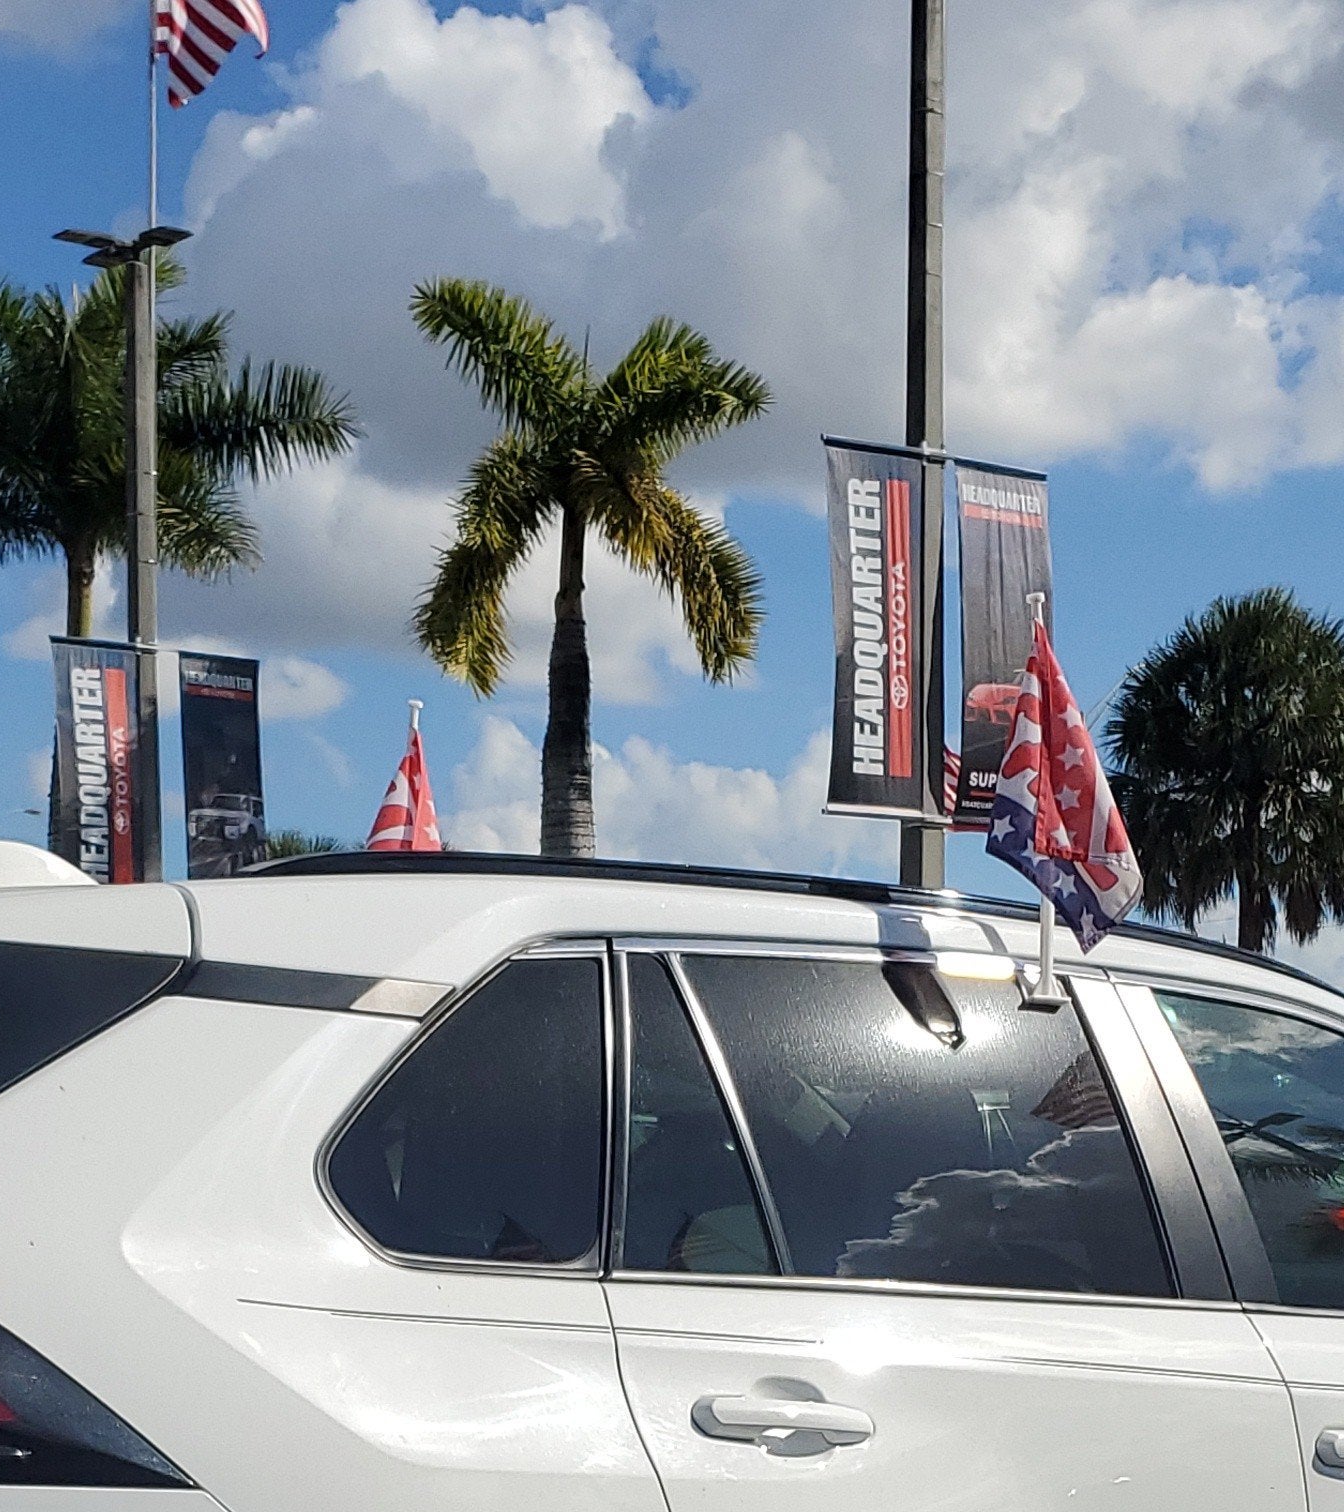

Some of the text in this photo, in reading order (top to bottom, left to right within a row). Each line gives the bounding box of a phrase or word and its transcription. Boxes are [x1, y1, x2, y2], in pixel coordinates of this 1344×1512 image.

[962, 483, 1042, 516] HEADQUARTER
[848, 477, 888, 777] HEADQUARTER
[891, 561, 907, 670] TOYOTA
[71, 667, 112, 884] HEADQUARTER
[112, 727, 129, 805] TOYOTA
